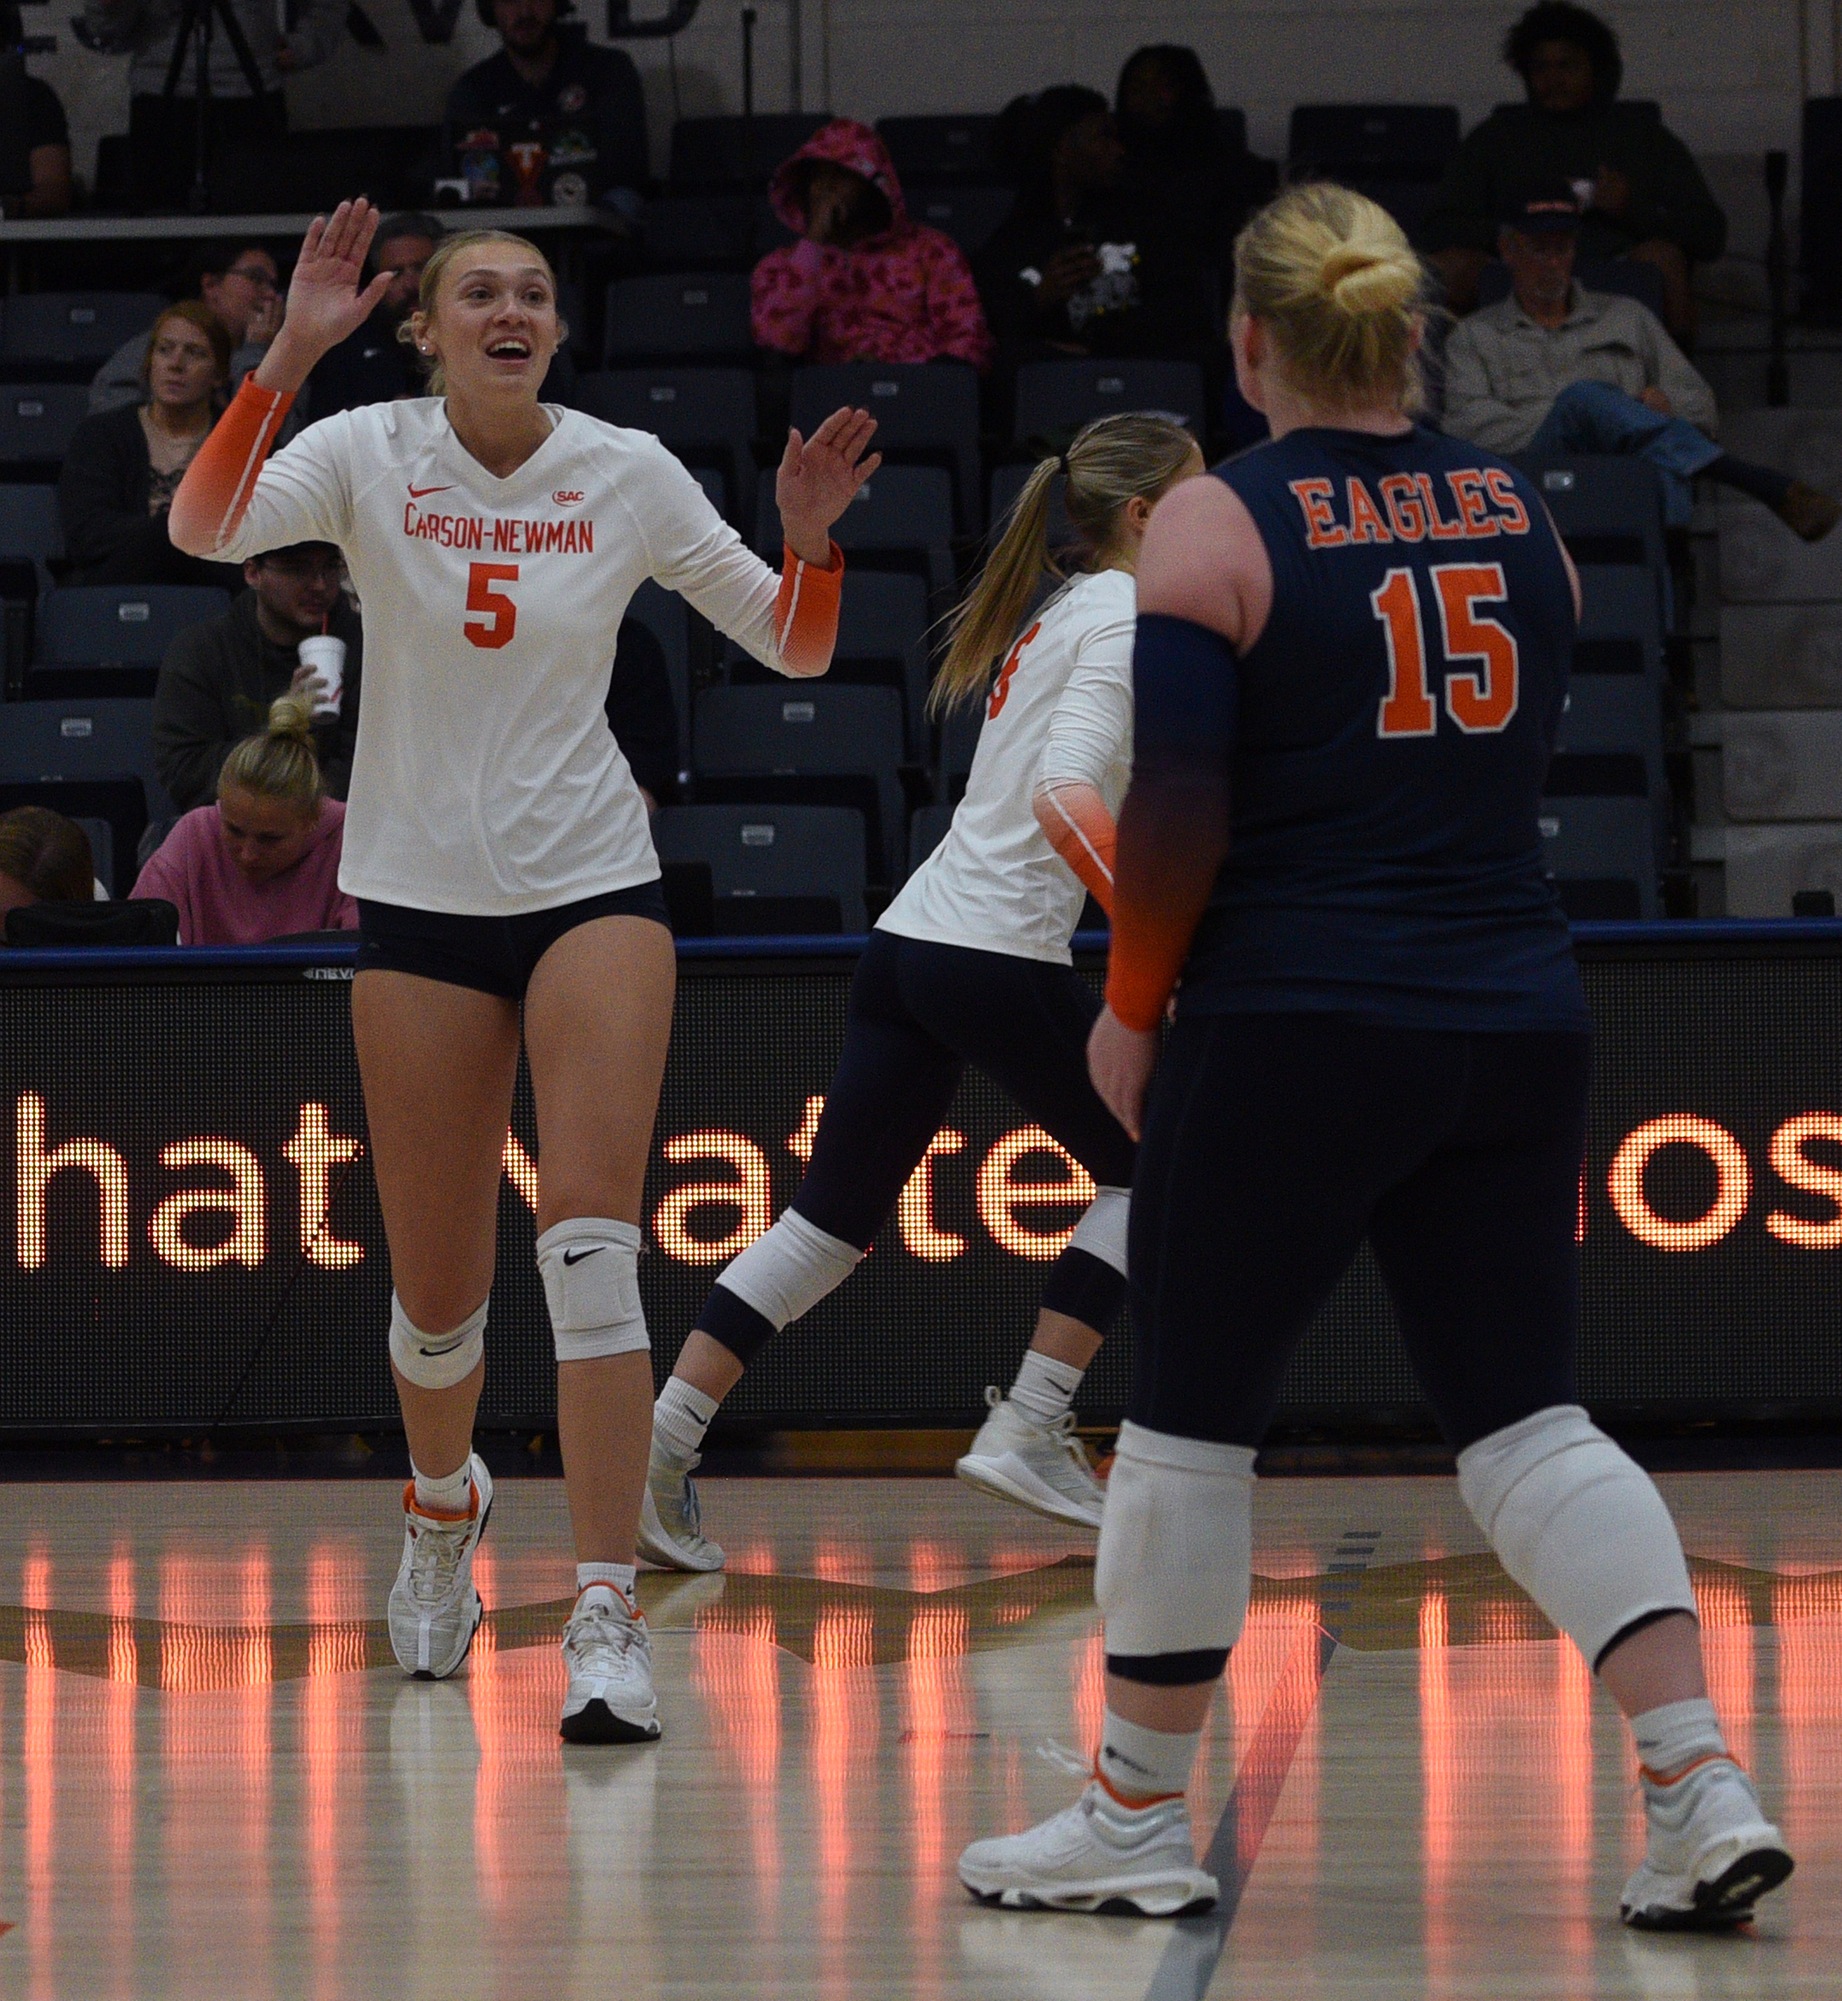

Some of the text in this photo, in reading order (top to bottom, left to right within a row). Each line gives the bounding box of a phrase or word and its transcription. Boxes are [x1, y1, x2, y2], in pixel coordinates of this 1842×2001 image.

[404, 501, 594, 554] CARSON-NEWMAN
[556, 490, 585, 502] SAC
[1288, 467, 1531, 550] EAGLES
[464, 562, 519, 650] 5
[1370, 561, 1519, 739] 15
